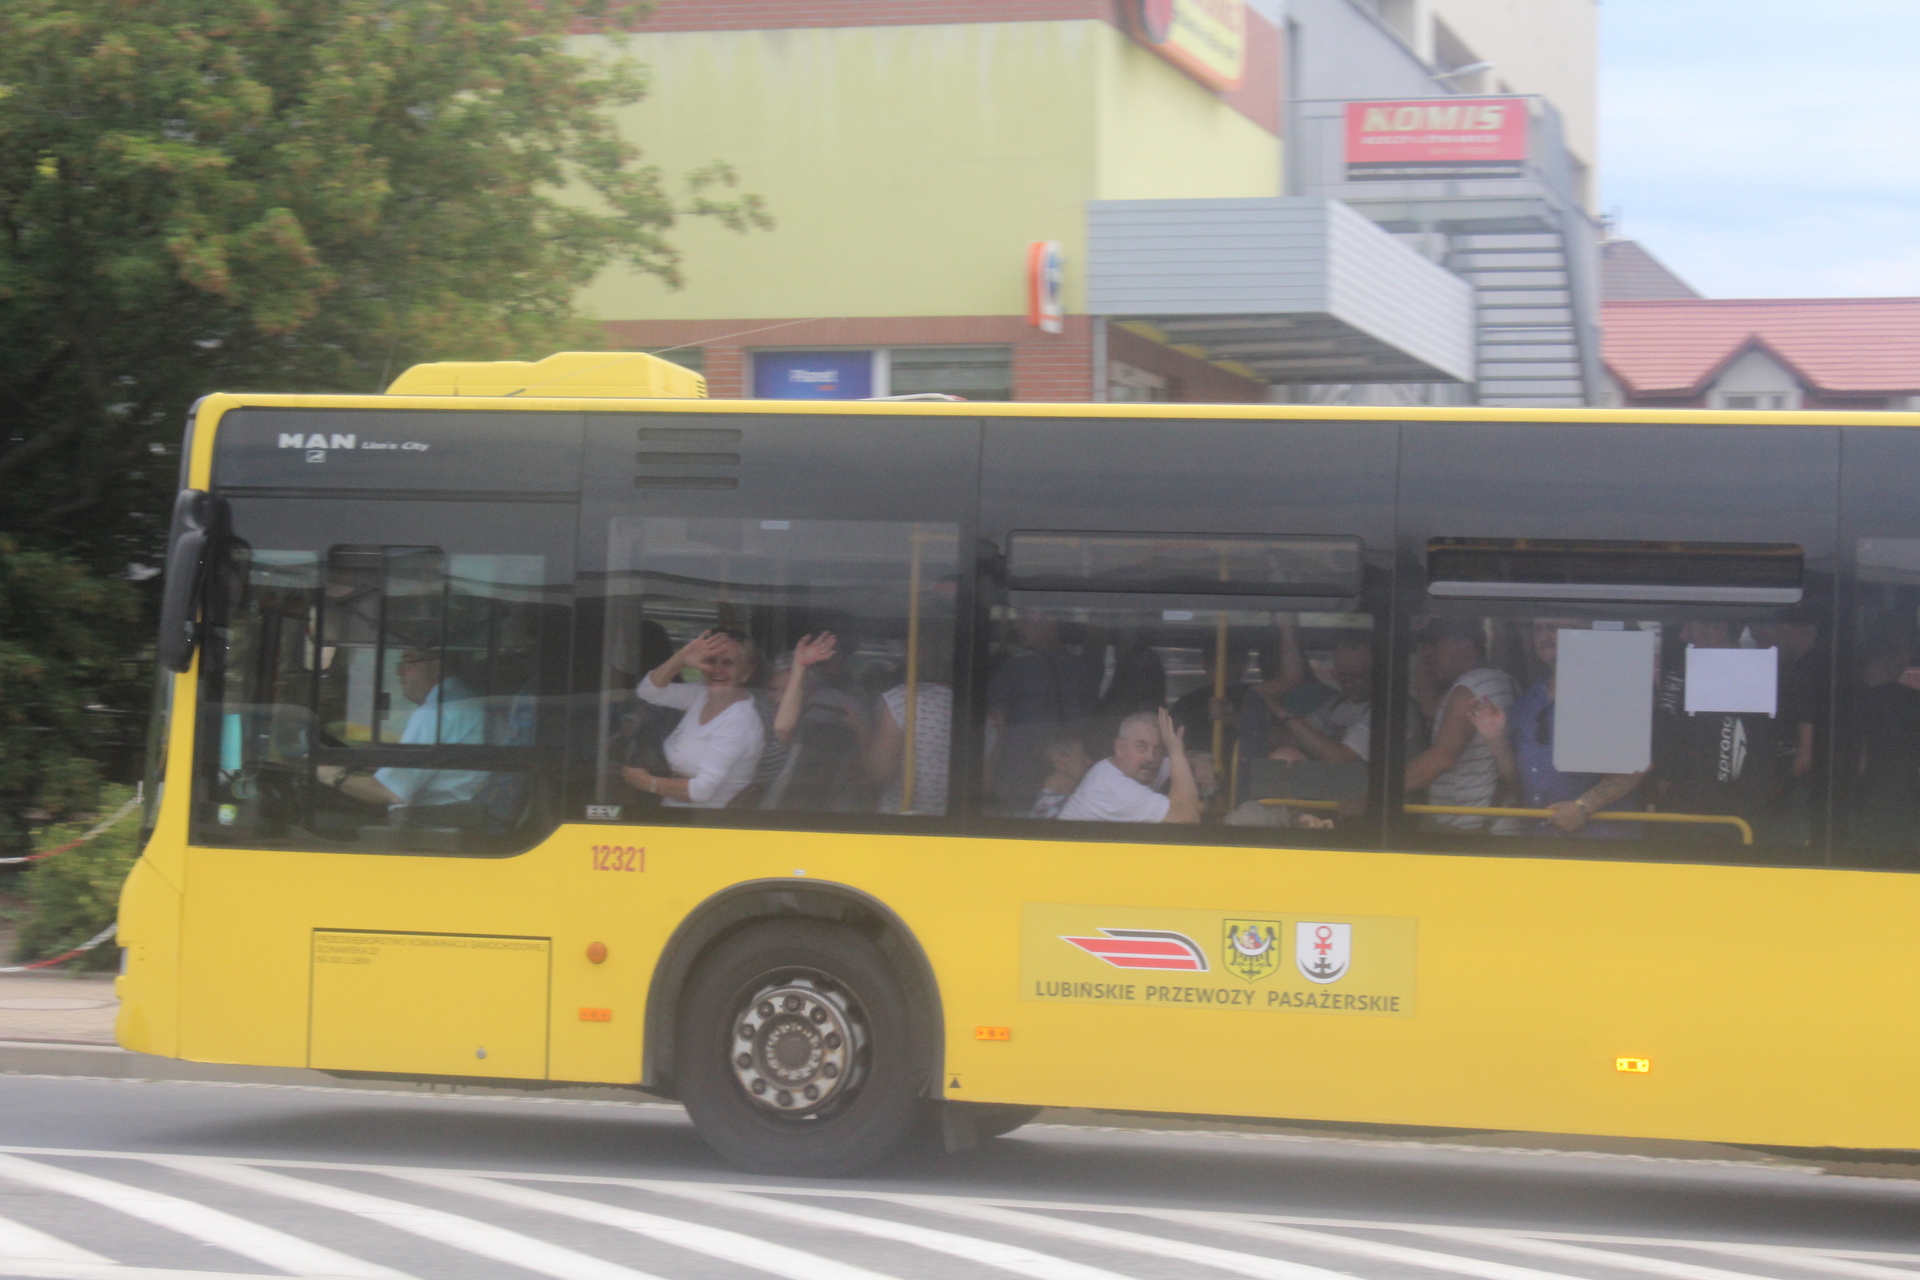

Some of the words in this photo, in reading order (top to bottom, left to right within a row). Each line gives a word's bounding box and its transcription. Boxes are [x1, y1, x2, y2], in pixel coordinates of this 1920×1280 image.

[1361, 105, 1507, 132] KOMIS
[278, 433, 356, 449] MAN
[401, 441, 430, 451] City
[587, 806, 619, 818] EEV
[591, 845, 646, 872] 12321
[1036, 980, 1135, 1000] LUBIŃSKIE
[1146, 985, 1255, 1005] PRZEWOZY
[1267, 990, 1400, 1012] PASAŻERSKIE
